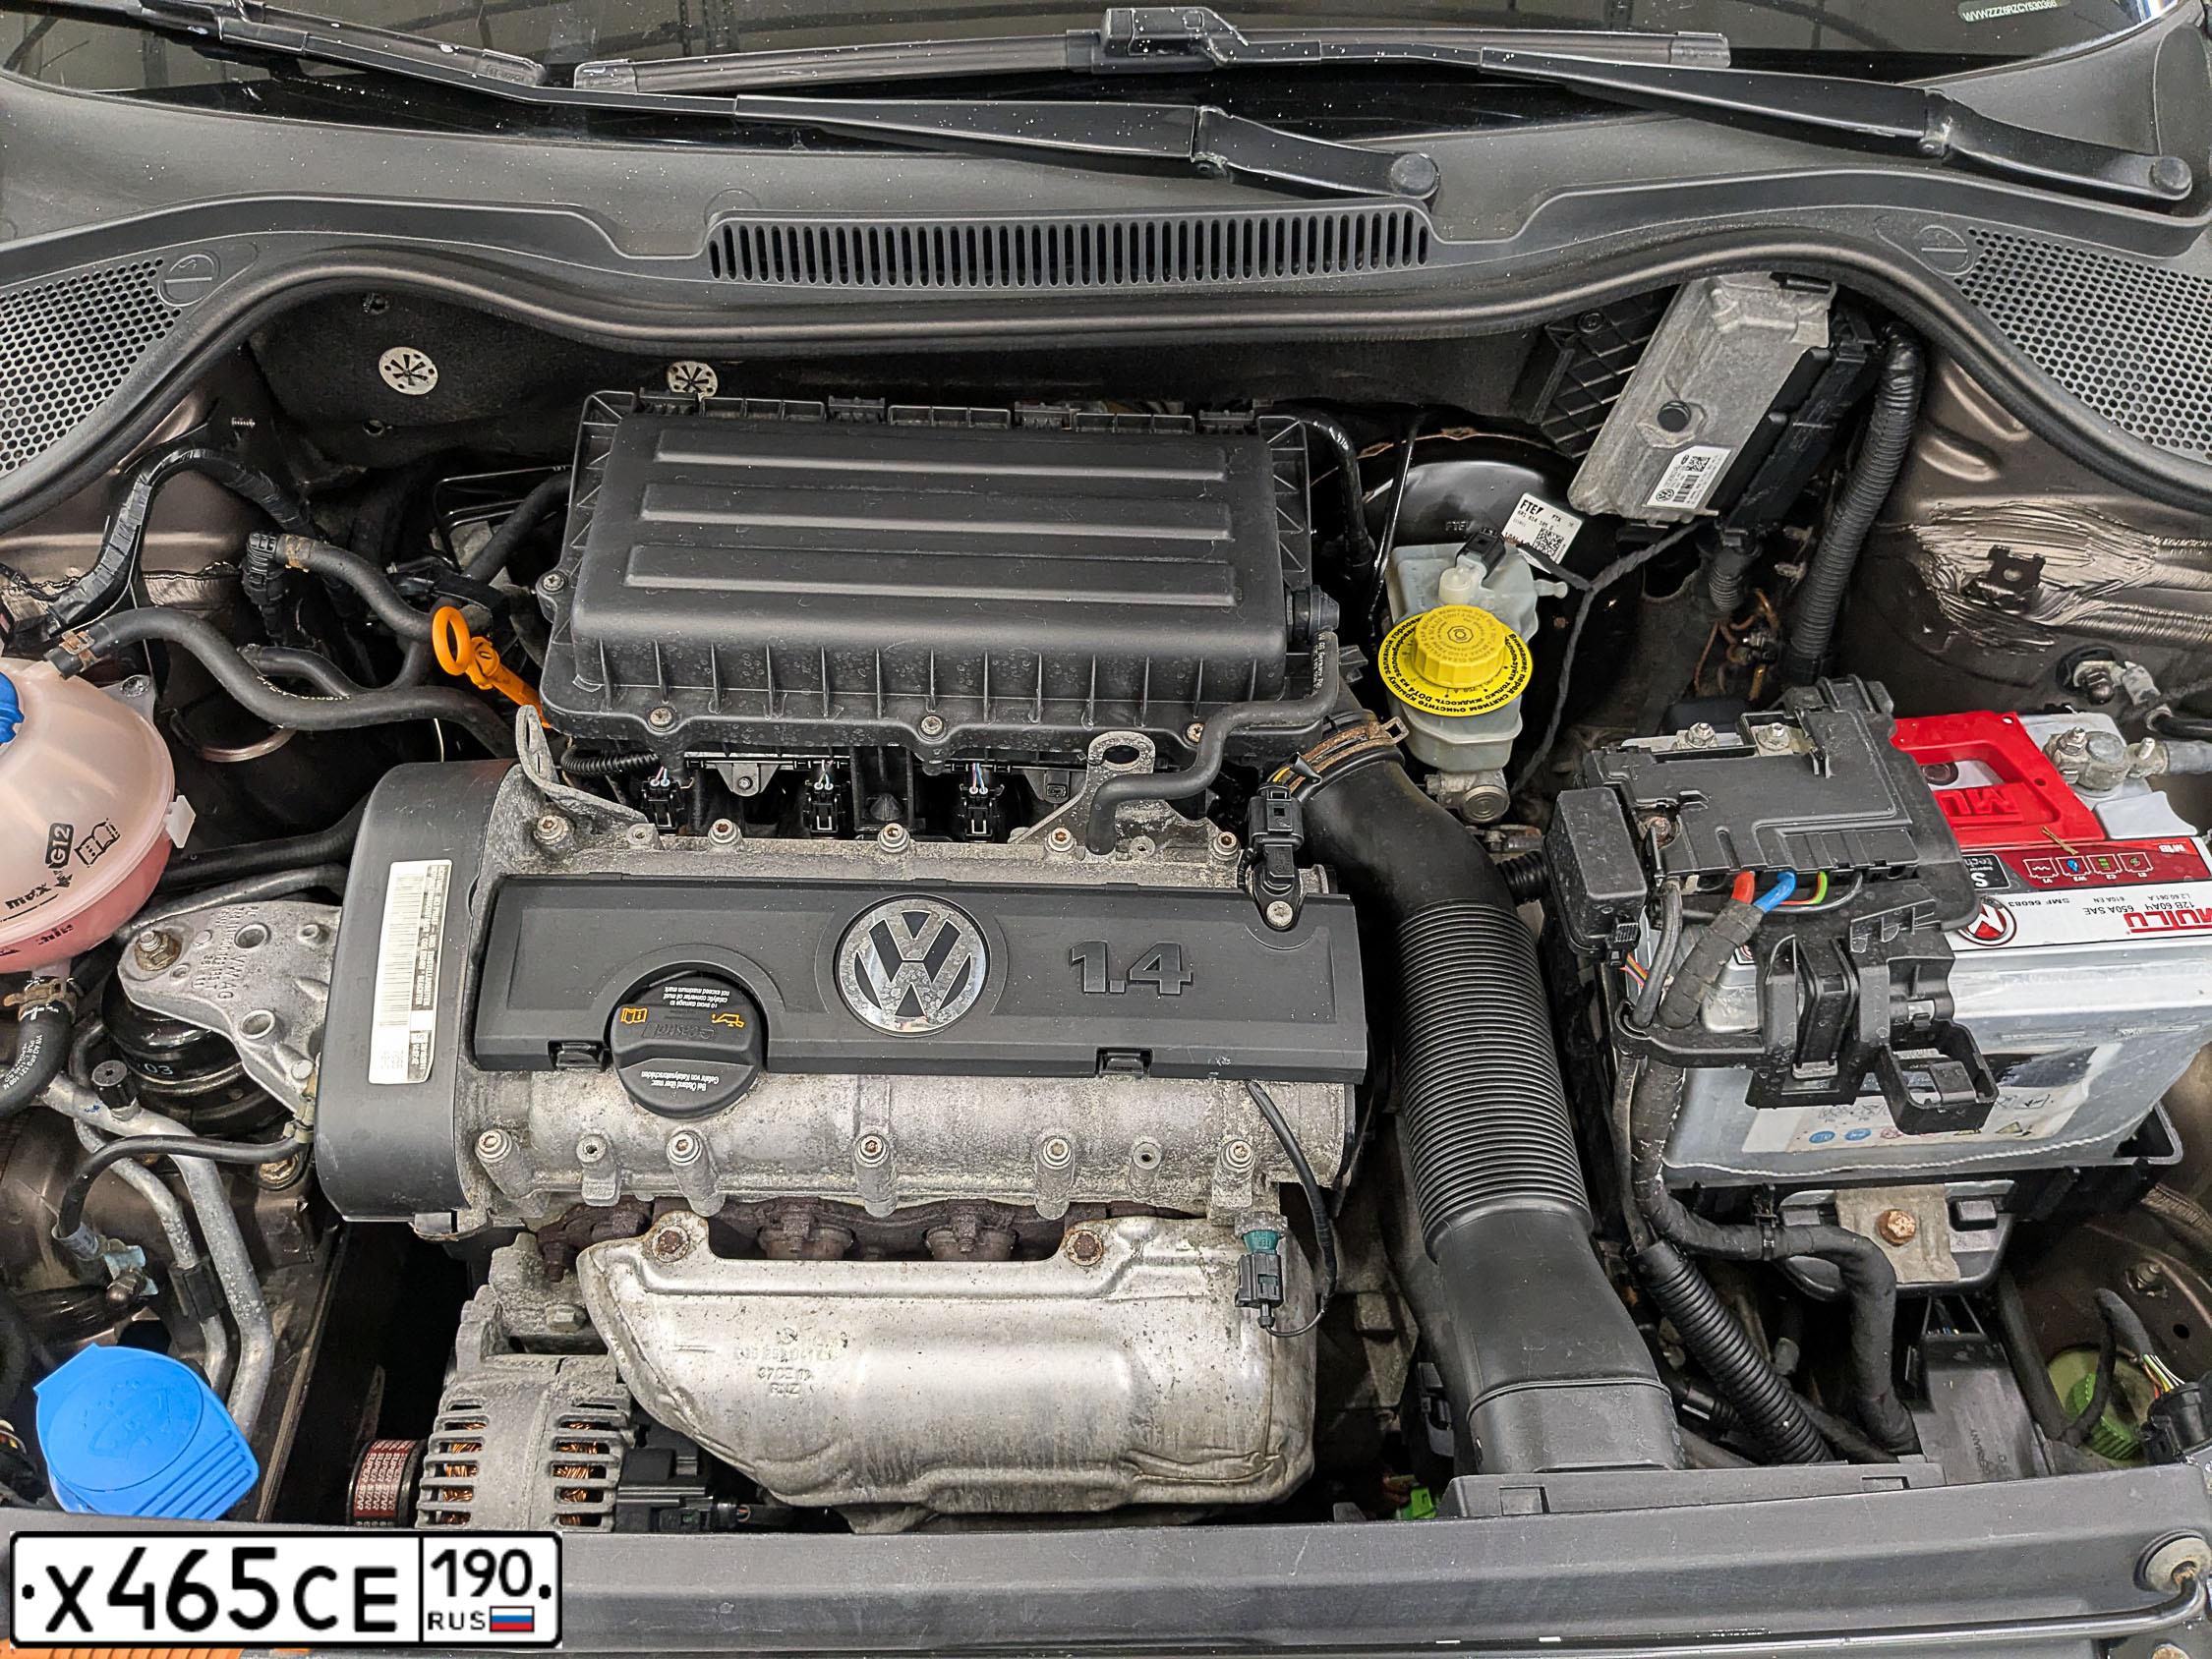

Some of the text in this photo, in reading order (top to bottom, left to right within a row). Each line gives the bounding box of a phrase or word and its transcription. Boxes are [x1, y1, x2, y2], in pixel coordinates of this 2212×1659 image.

[1381, 639, 1393, 674] заливной
[1388, 676, 1417, 703] крышку
[1484, 681, 1510, 700] только
[1511, 674, 1526, 695] перед
[1408, 686, 1432, 703] DOT4
[1435, 697, 1484, 707] жидкость
[1473, 694, 1509, 712] снятием
[1418, 699, 1466, 713] очистите
[50, 824, 72, 864] G12
[1970, 872, 1989, 887] S
[5, 884, 52, 910] max
[2083, 904, 2134, 916] 650A SAE
[1070, 941, 1193, 996] 1.4
[144, 1063, 173, 1075] 03
